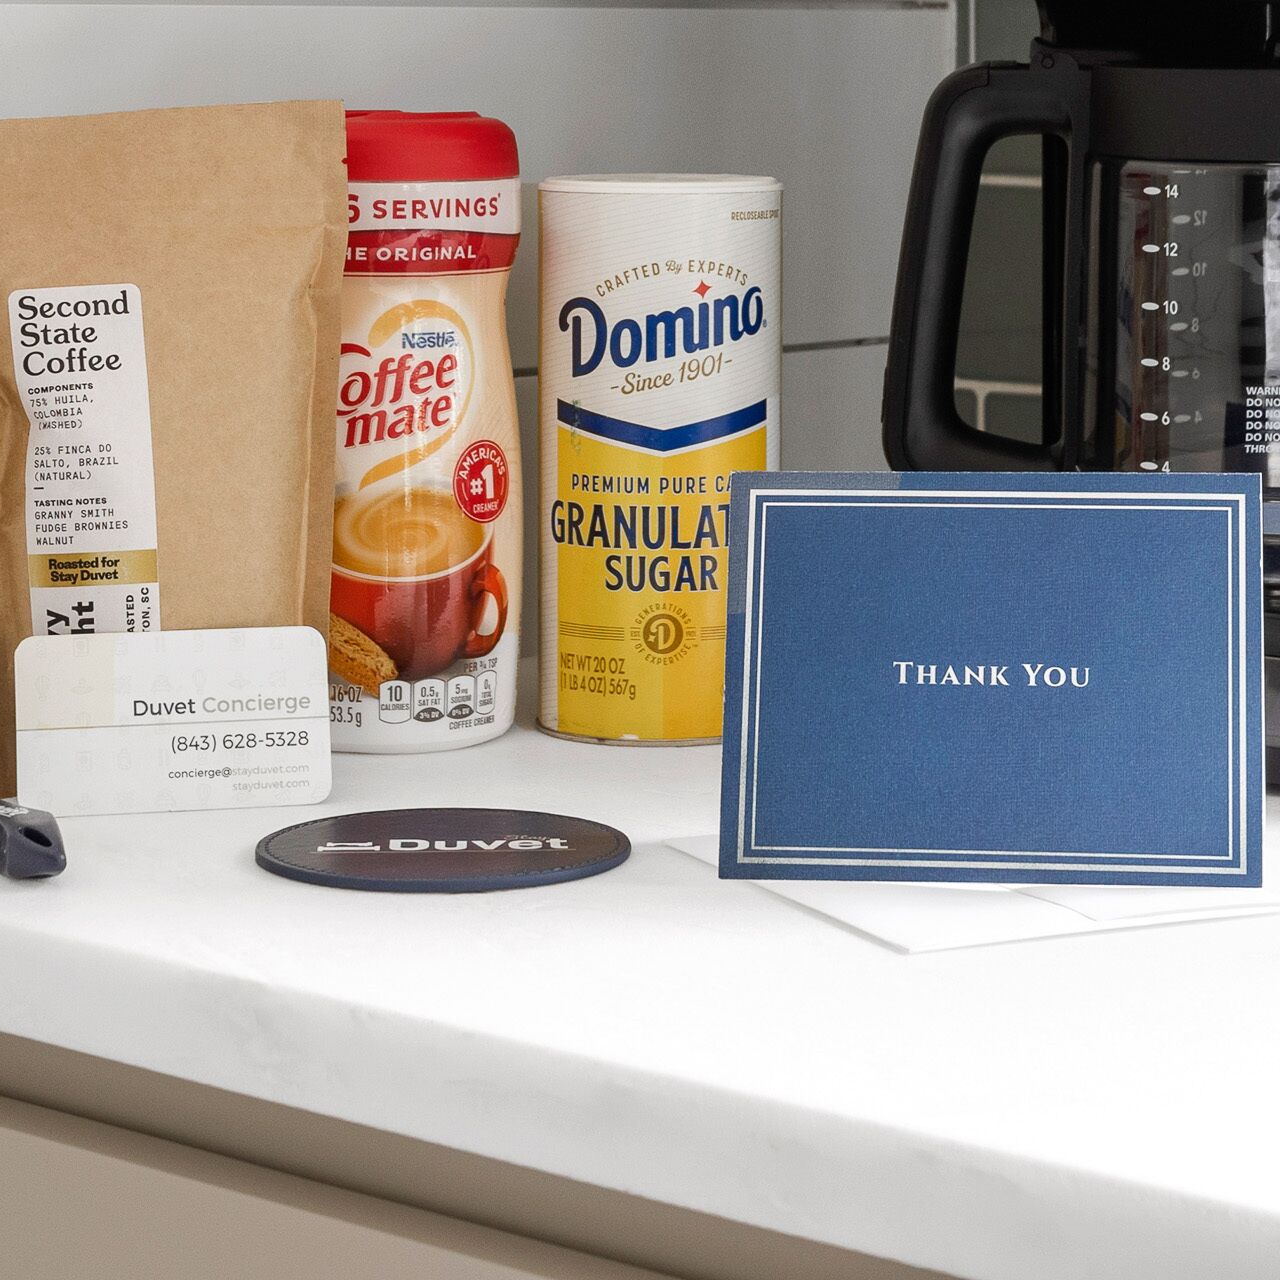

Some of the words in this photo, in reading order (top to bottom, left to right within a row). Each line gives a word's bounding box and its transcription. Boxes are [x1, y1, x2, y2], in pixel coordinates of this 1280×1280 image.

[1164, 184, 1179, 199] 14
[373, 196, 498, 219] SERVINGS
[376, 245, 477, 261] ORIGINAL
[1163, 242, 1178, 257] 12
[596, 262, 661, 297] CRAFTED
[665, 260, 683, 274] By
[688, 259, 748, 286] EXPERTS
[18, 290, 130, 320] Second
[1162, 301, 1178, 315] 10
[19, 322, 98, 347] State
[559, 286, 763, 378] Domino
[22, 348, 122, 377] Coffee
[1162, 356, 1170, 371] 8
[28, 383, 94, 395] COMPONENTS
[30, 398, 48, 408] 75%
[55, 395, 94, 405] HUILA,
[1246, 398, 1262, 407] DO
[34, 408, 83, 419] COLOMBIA
[344, 394, 453, 447] mate
[1161, 411, 1170, 425] 6
[1246, 410, 1262, 419] DO
[38, 419, 83, 430] (WASHED)
[1246, 421, 1262, 430] DO
[1245, 433, 1261, 442] DO
[34, 446, 51, 455] 25%
[58, 445, 91, 455] FINCA
[99, 444, 112, 452] DO
[34, 458, 70, 469] SALTO,
[79, 457, 119, 466] BRAZIL
[459, 448, 506, 479] AMERICA'S
[1161, 461, 1171, 473] 4
[34, 470, 92, 481] (NATURAL)
[470, 464, 494, 499] #1
[572, 473, 650, 494] PREMIUM
[659, 477, 706, 494] PURE
[34, 499, 73, 508] TASTING
[76, 497, 107, 506] NOTES
[34, 510, 73, 520] GRANNY
[81, 508, 114, 518] SMITH
[35, 523, 67, 533] FUDGE
[74, 520, 129, 532] BROWNIES
[36, 536, 74, 546] WALNUT
[48, 557, 99, 570] Roasted
[101, 557, 120, 568] for
[51, 570, 78, 585] Stay
[80, 570, 119, 581] Duvet
[605, 555, 718, 592] SUGAR
[141, 587, 149, 603] SC
[635, 602, 692, 625] GENERATIONS
[634, 643, 646, 654] OF
[645, 643, 691, 665] EXPERTISE
[560, 652, 575, 669] NET
[576, 655, 592, 672] WT
[594, 656, 606, 673] 20
[609, 658, 625, 674] OZ
[569, 674, 578, 690] LB
[580, 675, 586, 691] 4
[588, 676, 607, 697] OZ)
[348, 686, 362, 703] OZ
[387, 685, 402, 702] 10
[133, 699, 195, 717] Duvet
[202, 693, 311, 714] Concierge
[381, 703, 409, 711] CALORIES
[449, 720, 473, 730] COFFEE
[171, 734, 217, 754] (843)
[222, 730, 309, 750] 628-5328
[168, 763, 310, 780] concierge@stayduvet.com
[232, 779, 310, 792] stayduvet.com
[389, 838, 568, 850] Duvet
